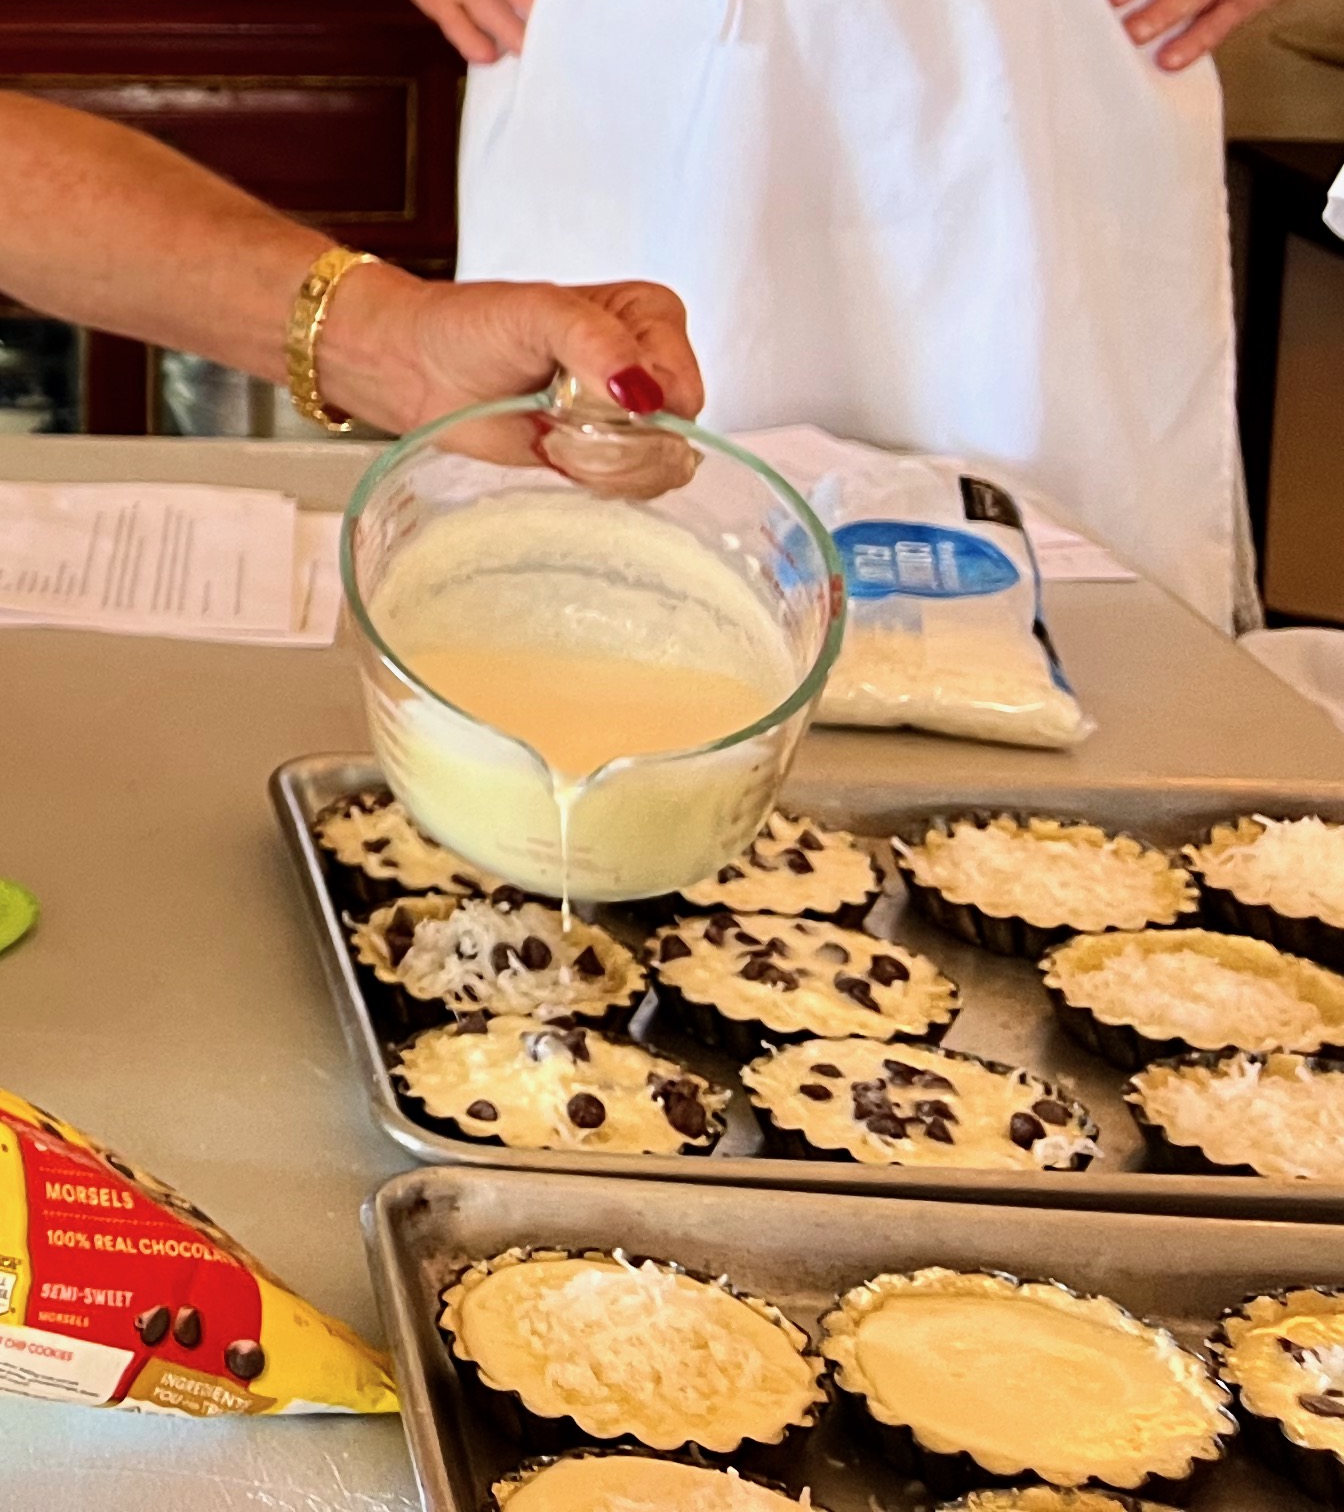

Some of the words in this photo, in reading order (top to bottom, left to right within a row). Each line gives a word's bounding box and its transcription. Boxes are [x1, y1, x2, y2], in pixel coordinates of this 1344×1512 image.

[45, 1181, 135, 1210] MORSELS
[47, 1229, 91, 1250] 100%
[93, 1233, 137, 1254] REAL
[40, 1283, 134, 1308] SEMI-SWEET
